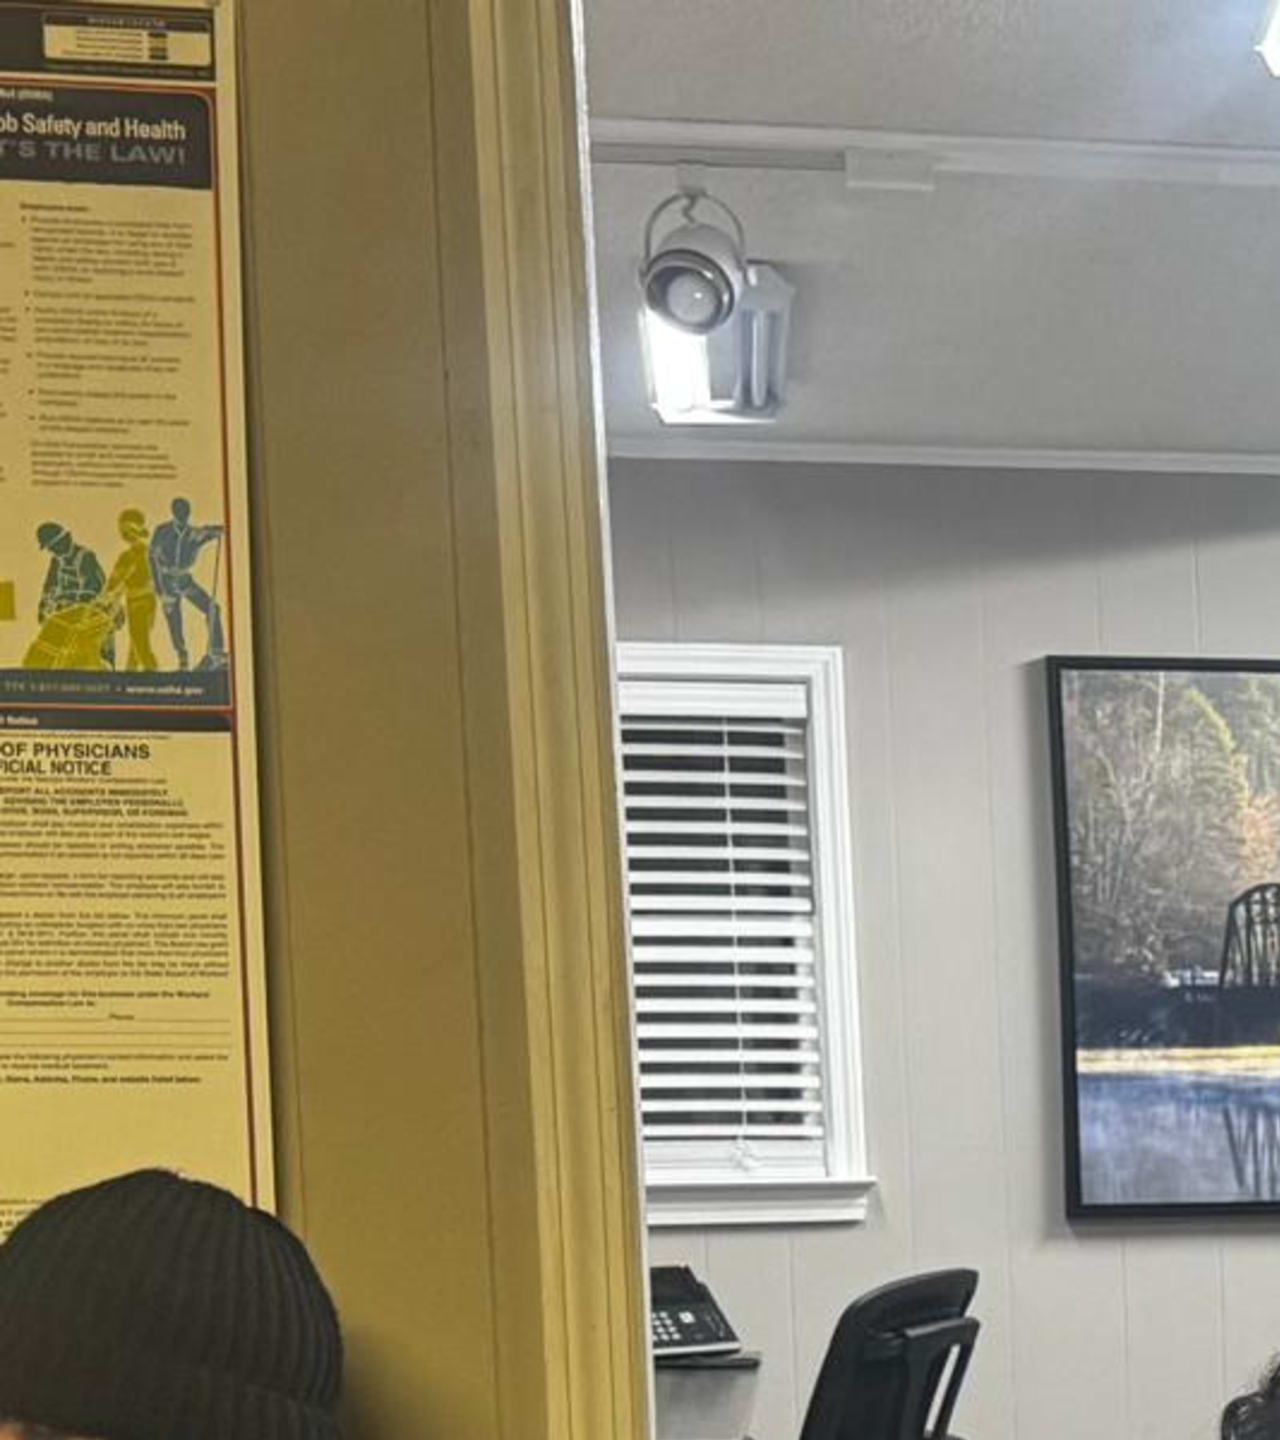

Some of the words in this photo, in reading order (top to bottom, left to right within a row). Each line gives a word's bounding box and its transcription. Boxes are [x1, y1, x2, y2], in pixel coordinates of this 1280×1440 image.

[22, 112, 83, 139] Safety
[86, 117, 120, 138] and
[124, 118, 186, 141] Health
[42, 141, 101, 161] THE
[110, 144, 187, 166] LAW!
[0, 742, 28, 758] OF
[33, 742, 151, 760] PHYSICIANS
[51, 760, 112, 776] NOTICE
